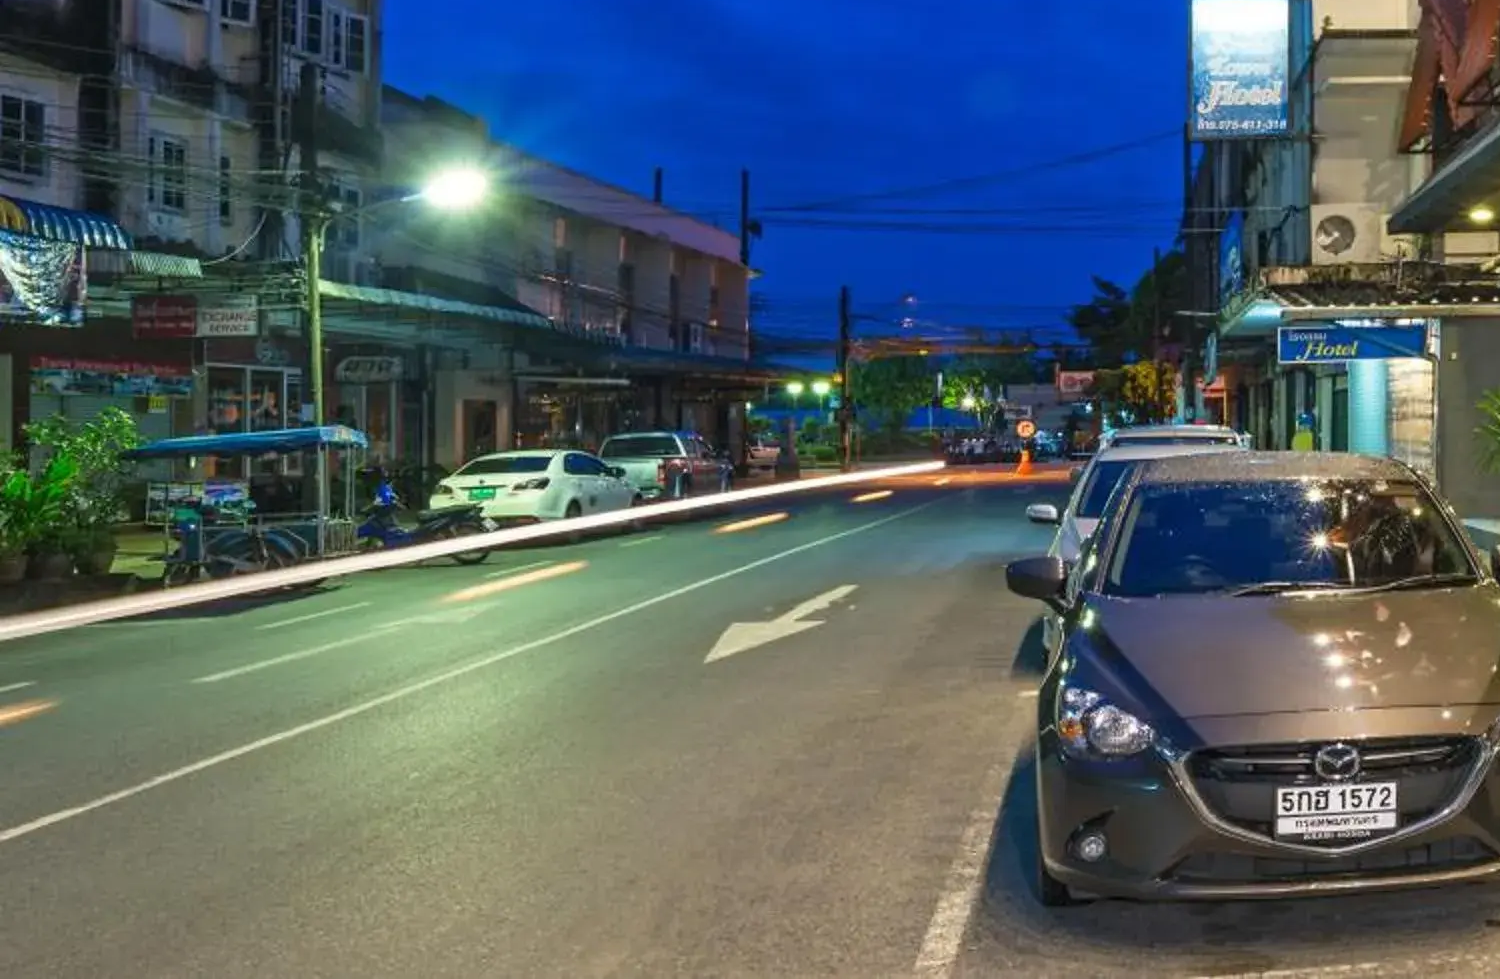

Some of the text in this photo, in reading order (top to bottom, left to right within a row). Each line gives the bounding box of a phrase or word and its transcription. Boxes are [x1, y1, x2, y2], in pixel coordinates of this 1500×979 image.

[1198, 80, 1284, 114] Hotel
[1296, 340, 1358, 361] Hotel
[1282, 787, 1391, 812] 5กฮ 1572
